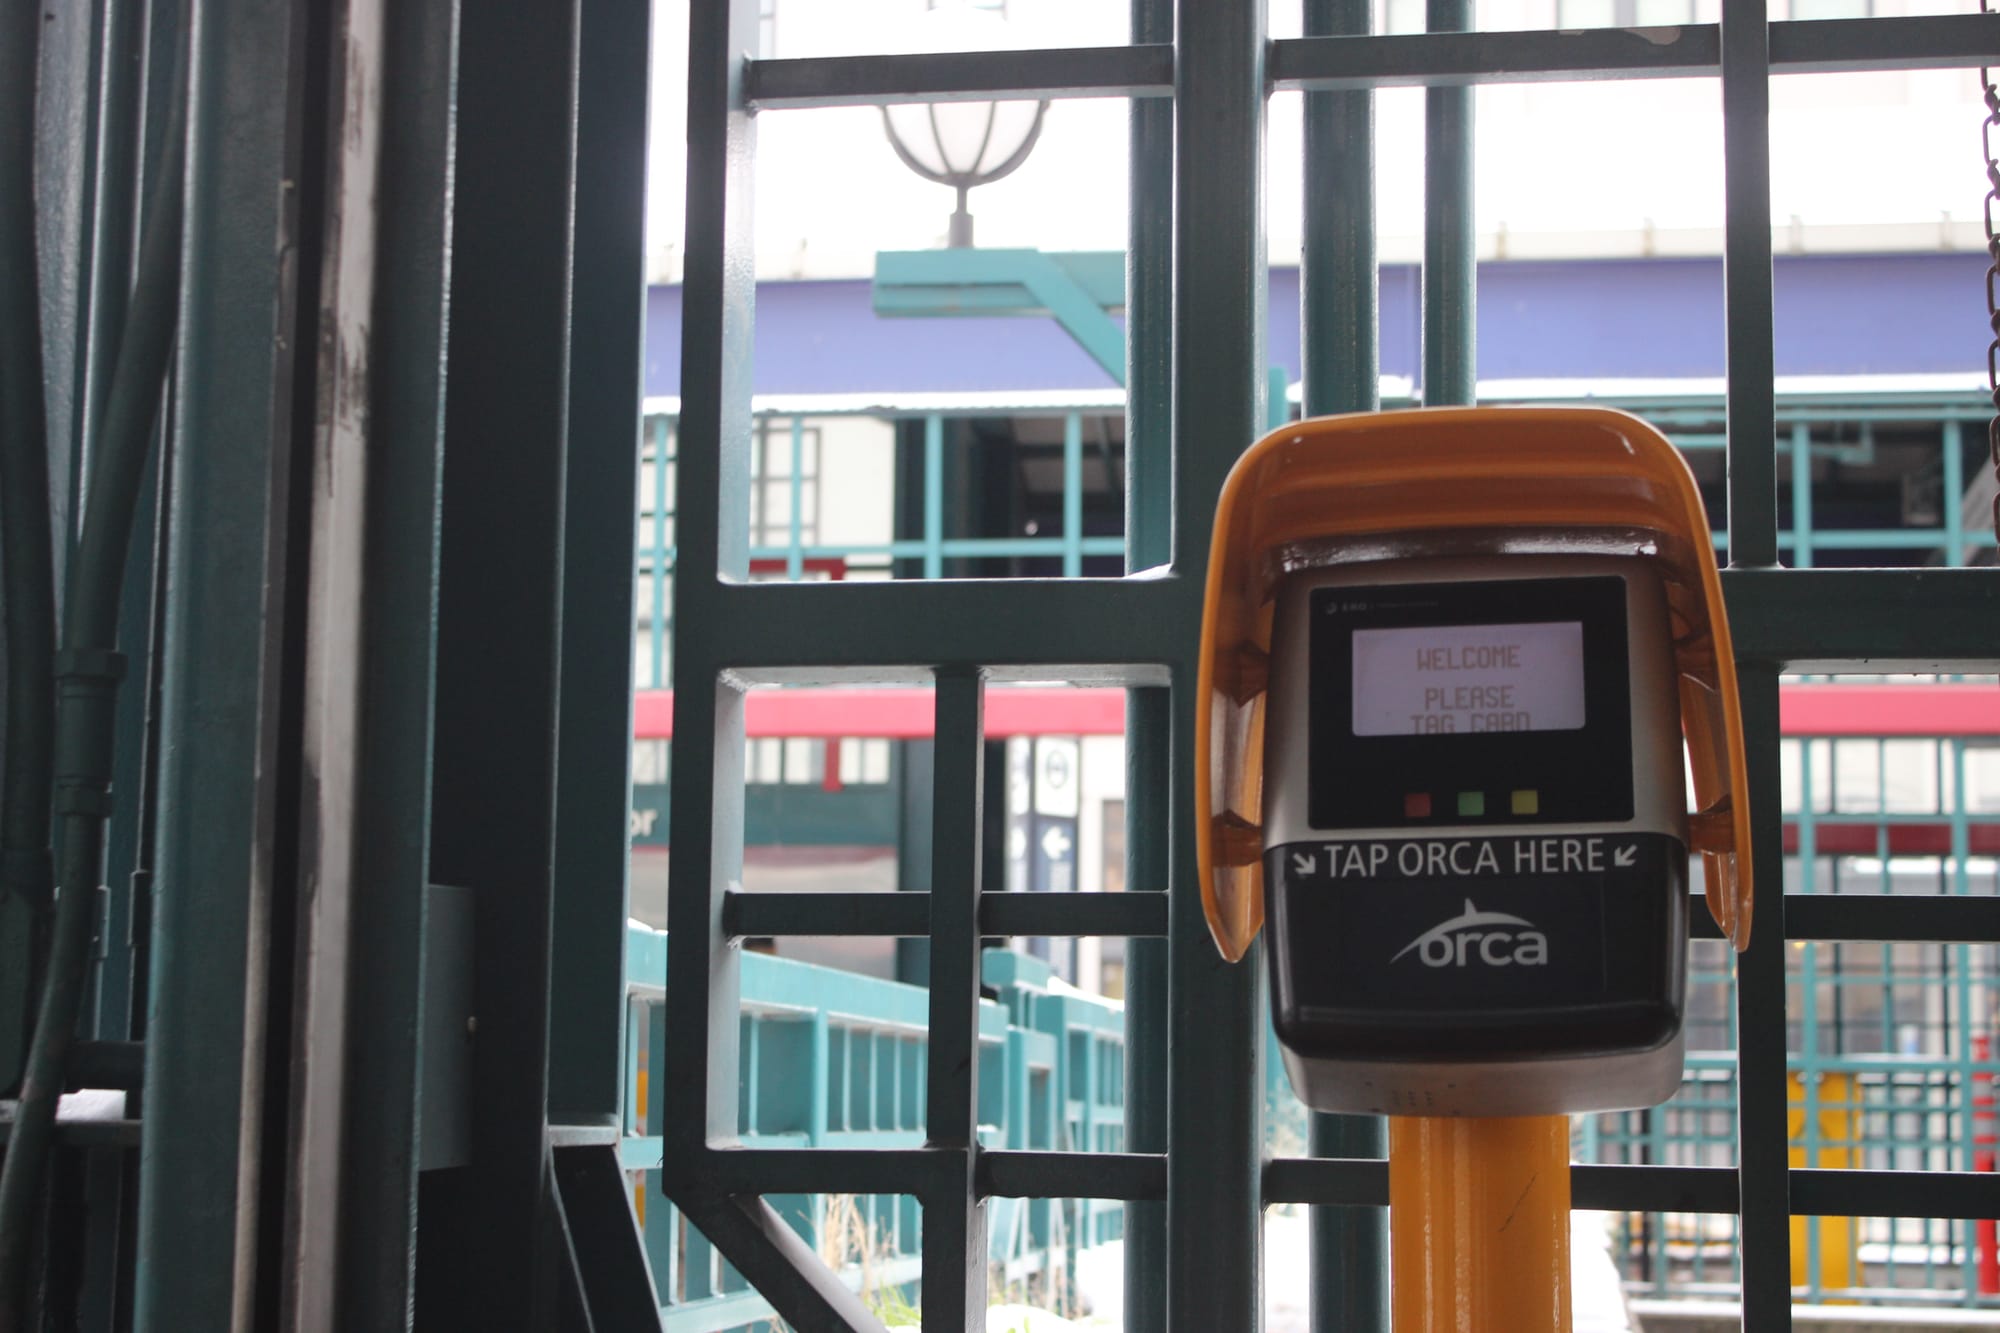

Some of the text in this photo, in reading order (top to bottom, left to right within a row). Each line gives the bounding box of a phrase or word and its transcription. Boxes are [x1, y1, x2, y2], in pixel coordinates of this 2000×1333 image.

[1417, 645, 1521, 671] WELCOME
[1425, 685, 1515, 710] PLEASE
[1411, 714, 1455, 734] TAG
[1325, 839, 1605, 877] TAP ORCA HERE
[1419, 931, 1548, 967] orca
